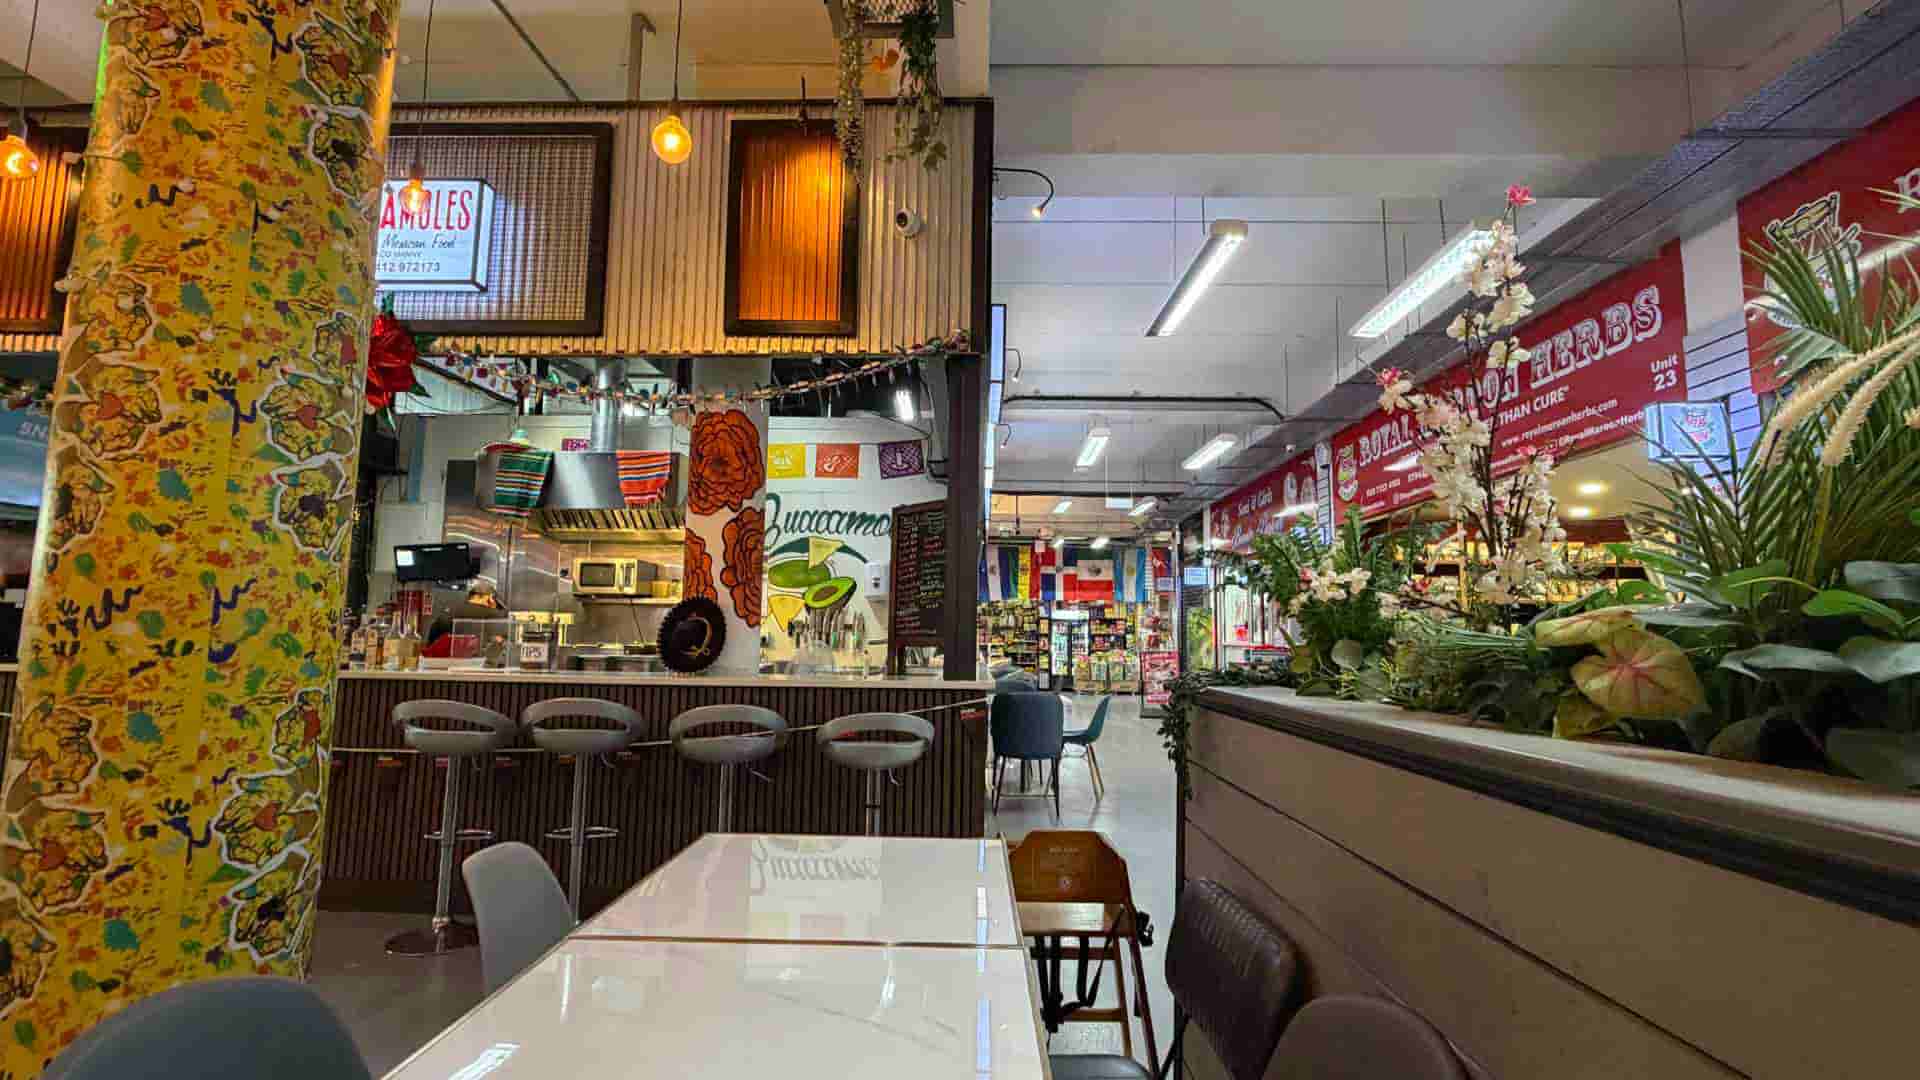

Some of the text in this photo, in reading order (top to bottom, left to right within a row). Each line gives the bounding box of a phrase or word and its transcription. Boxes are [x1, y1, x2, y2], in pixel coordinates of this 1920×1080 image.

[382, 232, 457, 249] Mexican Food
[1531, 285, 1662, 389] HERBS
[1651, 353, 1678, 373] Unit
[1654, 370, 1677, 392] 23
[1499, 401, 1531, 425] THAN
